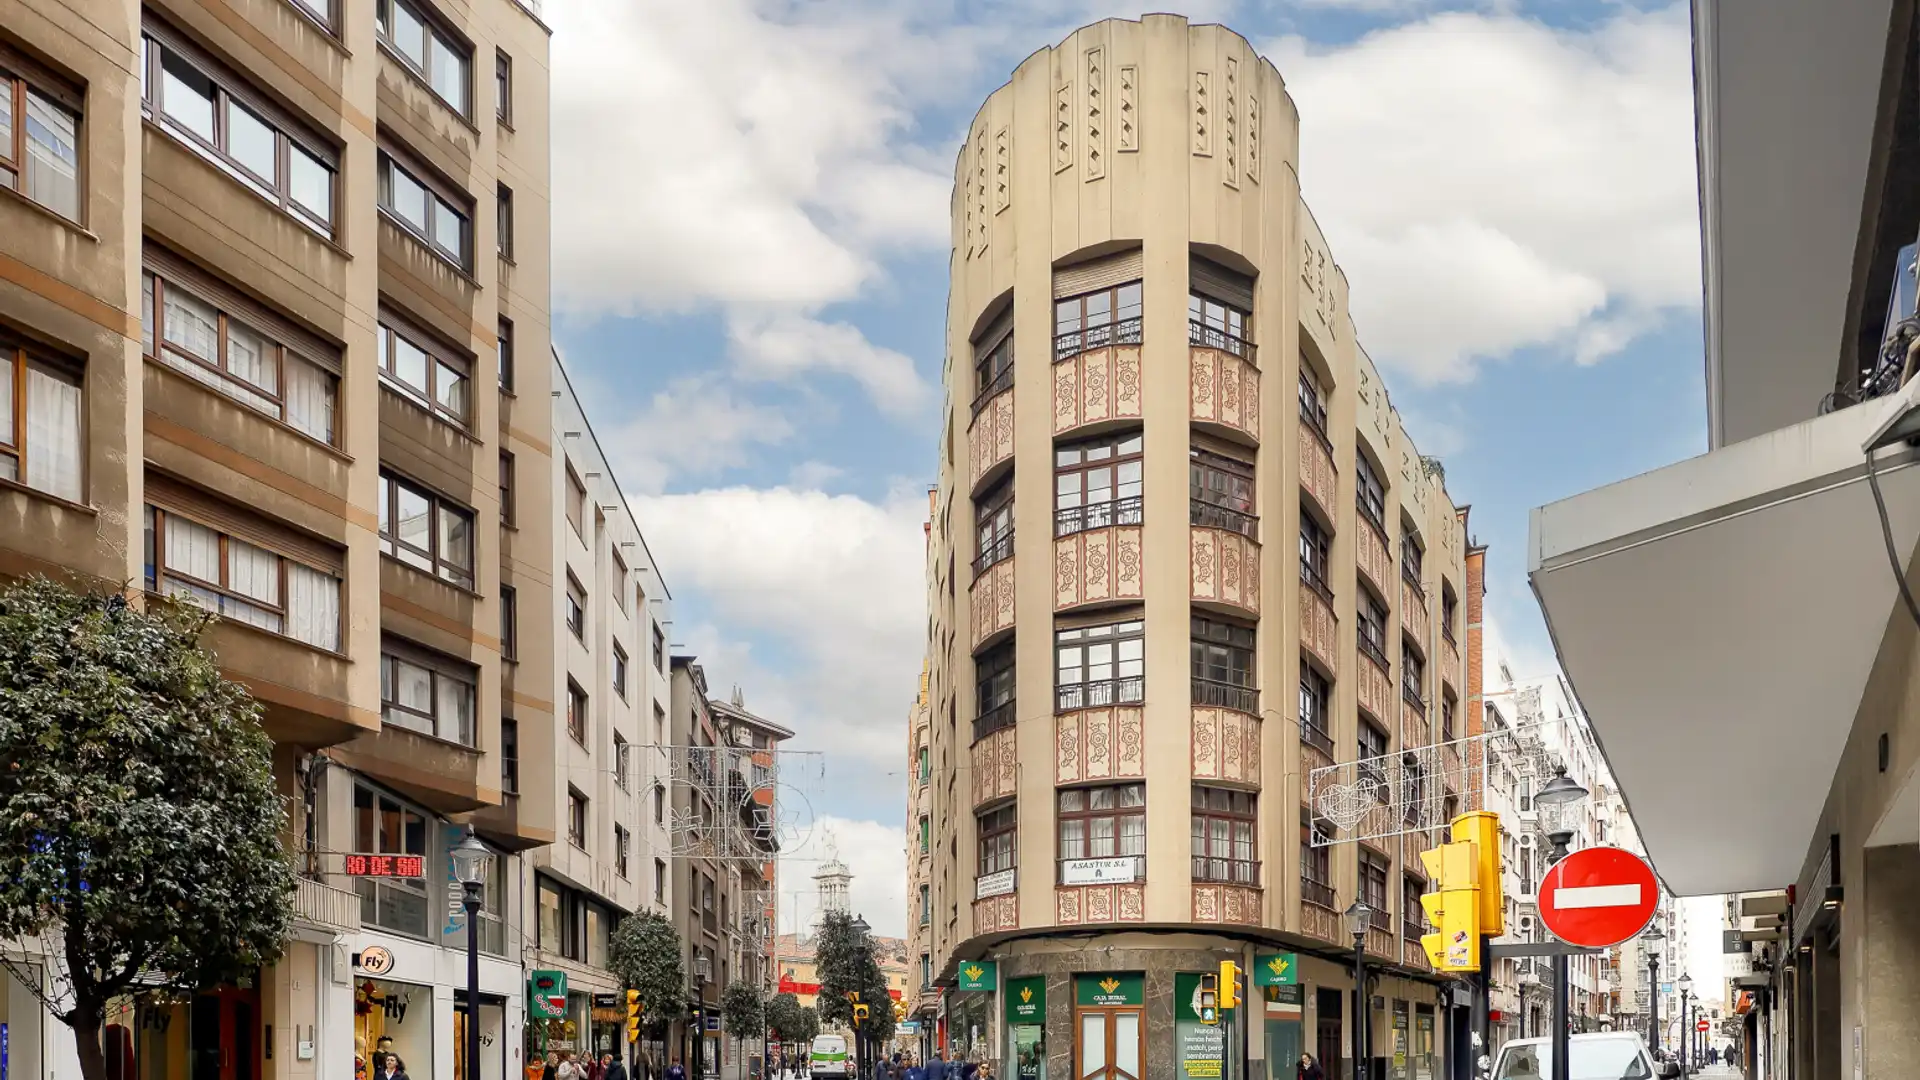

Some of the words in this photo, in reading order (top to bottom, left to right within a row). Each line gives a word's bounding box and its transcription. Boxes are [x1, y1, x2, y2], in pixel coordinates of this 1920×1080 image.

[371, 856, 392, 875] DE
[1071, 861, 1112, 869] ASASTUR
[365, 956, 384, 969] Fly
[385, 994, 407, 1024] Fly
[143, 1005, 171, 1033] Fly
